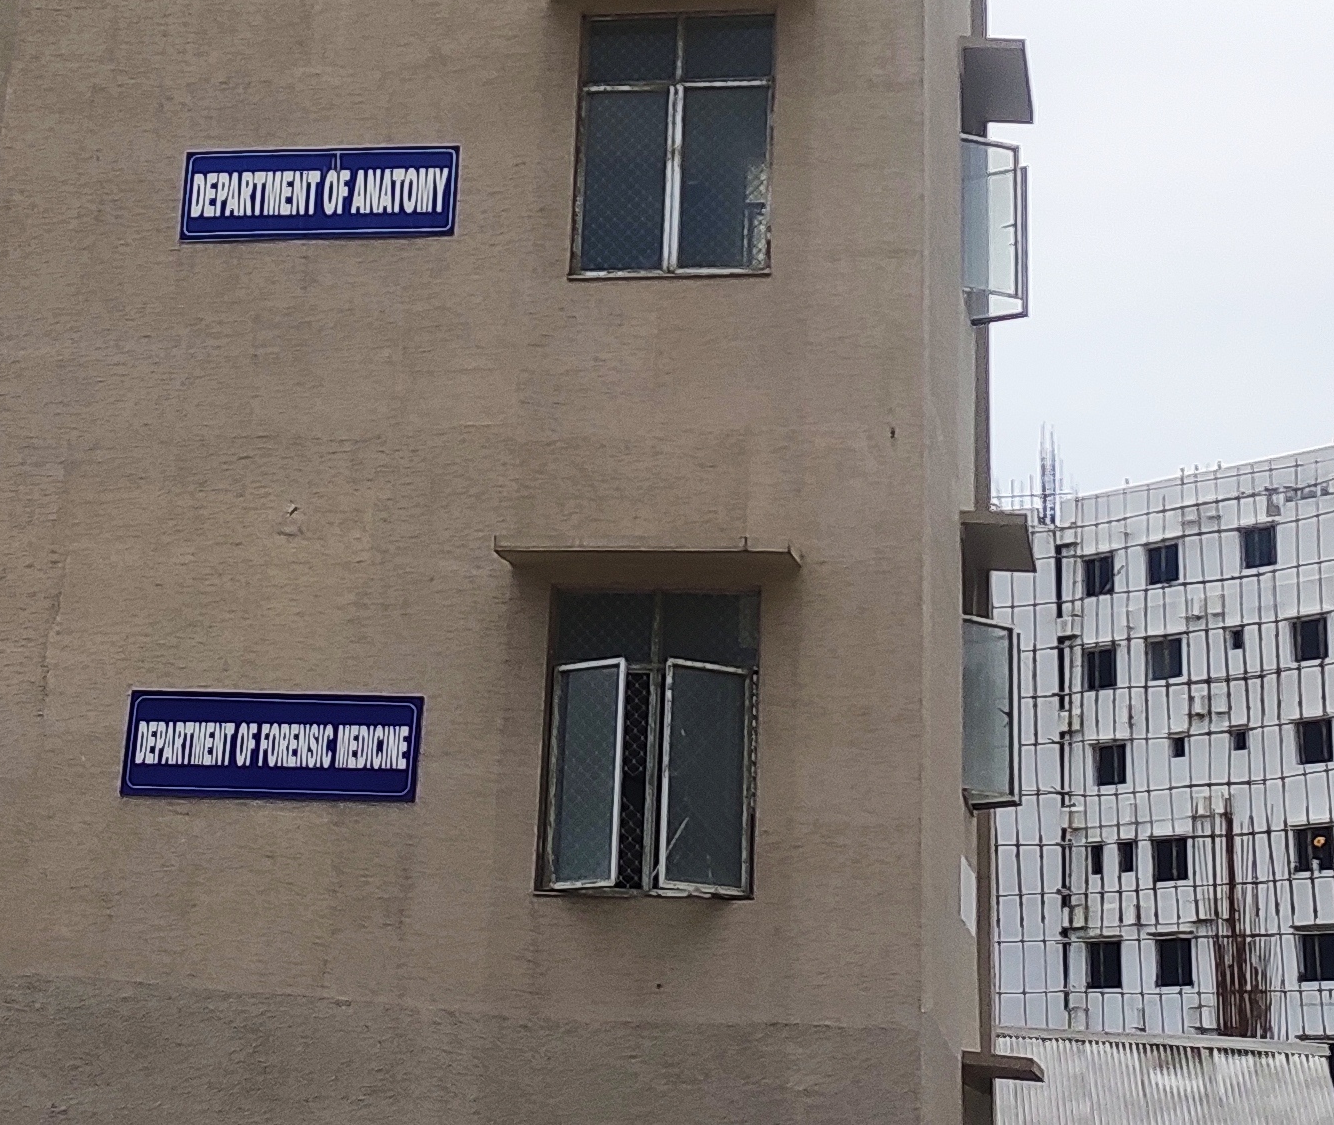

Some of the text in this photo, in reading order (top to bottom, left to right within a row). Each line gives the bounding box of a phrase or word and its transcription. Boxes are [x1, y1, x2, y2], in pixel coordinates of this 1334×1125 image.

[190, 168, 449, 217] DEPARTMENT OF ANATOMY
[135, 721, 409, 769] DEPARTMENT OF FORENSIC MEDICINE
